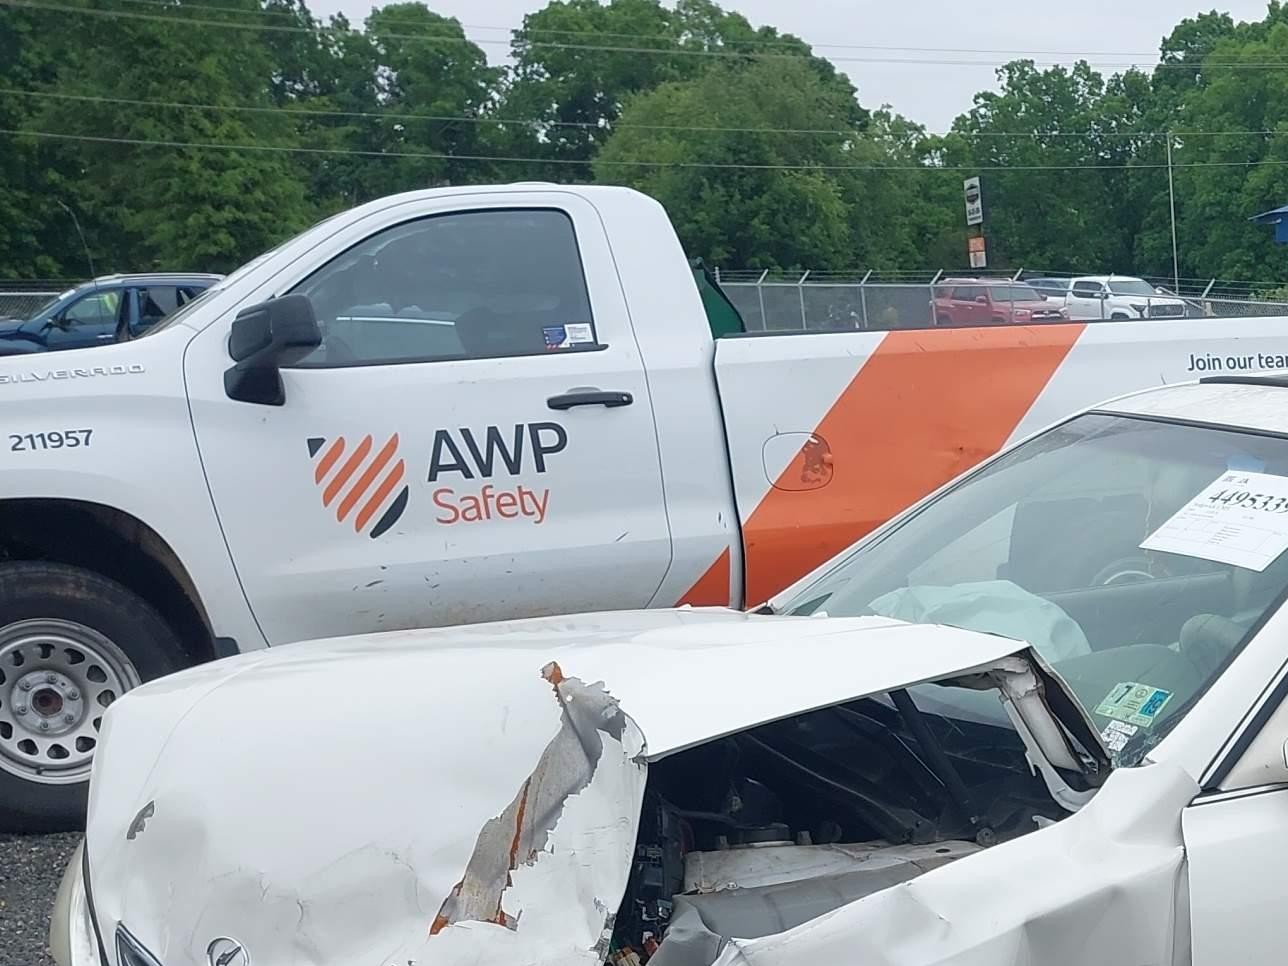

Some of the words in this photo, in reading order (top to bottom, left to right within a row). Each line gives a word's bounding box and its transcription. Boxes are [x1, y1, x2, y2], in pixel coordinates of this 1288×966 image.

[0, 364, 145, 384] SILVERADO
[1187, 354, 1222, 371] Join
[1226, 356, 1254, 370] our
[9, 429, 93, 452] 211957
[427, 421, 568, 482] AWP
[432, 484, 550, 524] Safety
